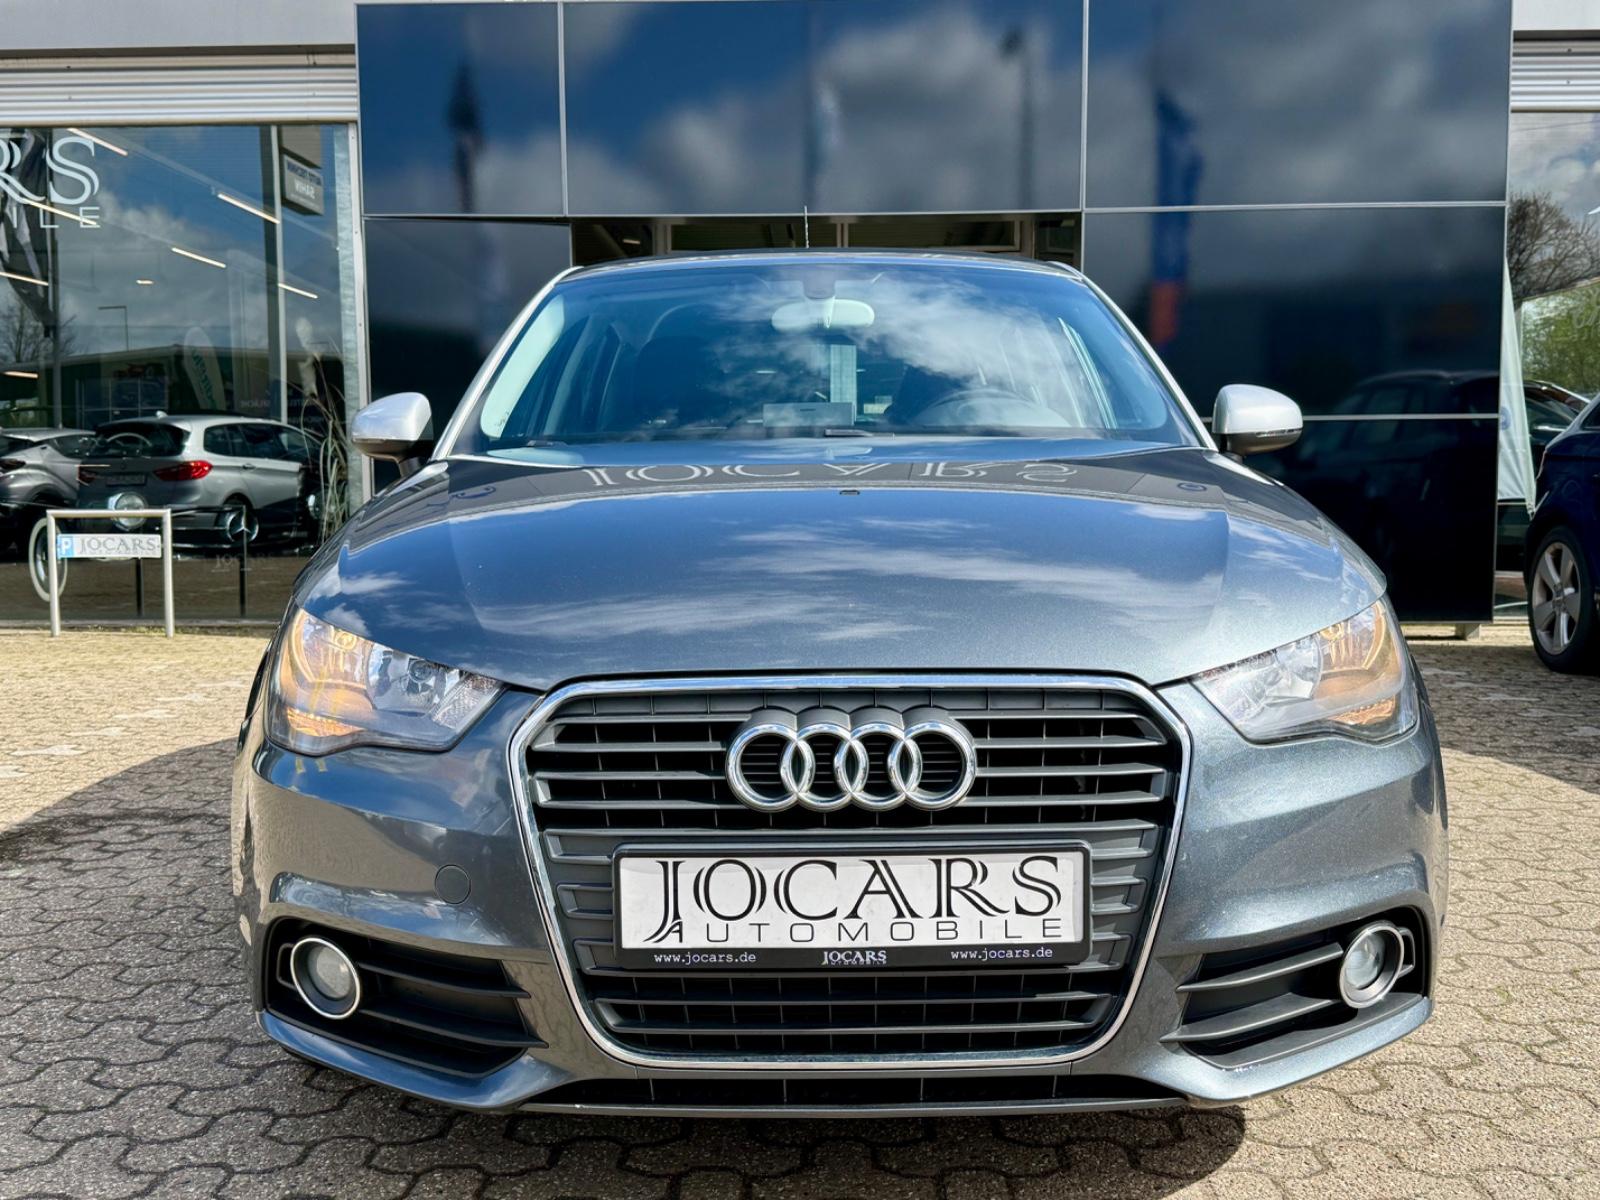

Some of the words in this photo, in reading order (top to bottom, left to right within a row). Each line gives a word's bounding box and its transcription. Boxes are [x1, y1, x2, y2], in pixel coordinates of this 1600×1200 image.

[80, 537, 156, 554] JOCARS
[643, 855, 1062, 943] JOCARS
[653, 918, 1062, 943] AUTOMOBILE
[653, 952, 757, 965] www.jocars.de
[821, 950, 887, 965] JOCARS
[950, 947, 1053, 961] www.jocars.de
